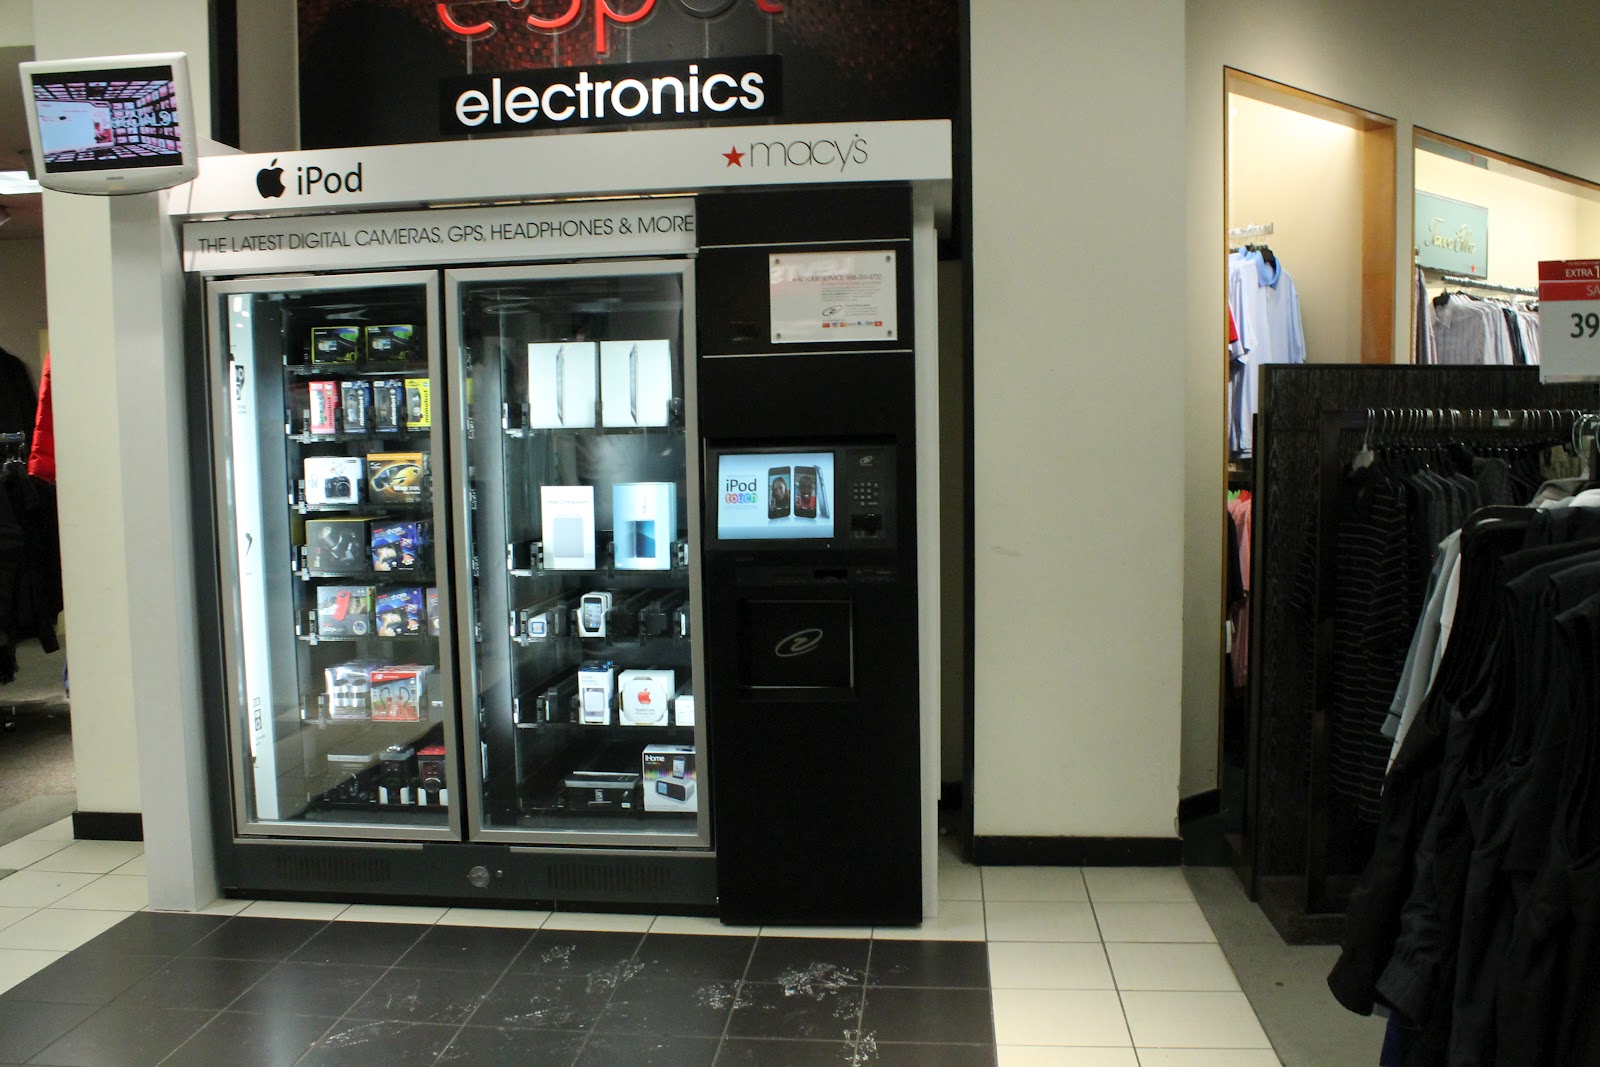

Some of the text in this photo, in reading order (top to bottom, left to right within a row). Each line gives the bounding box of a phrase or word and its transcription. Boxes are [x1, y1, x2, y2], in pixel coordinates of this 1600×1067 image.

[454, 64, 765, 128] electronics
[296, 161, 363, 196] iPod
[198, 214, 694, 254] THE LATEST DIGITAL CAMERAS, GPS, HEADPHONES & MORE
[1565, 268, 1593, 278] EXTRA
[1570, 313, 1600, 338] 39
[726, 478, 757, 492] iPod
[725, 492, 758, 504] touch
[645, 754, 666, 762] iHome
